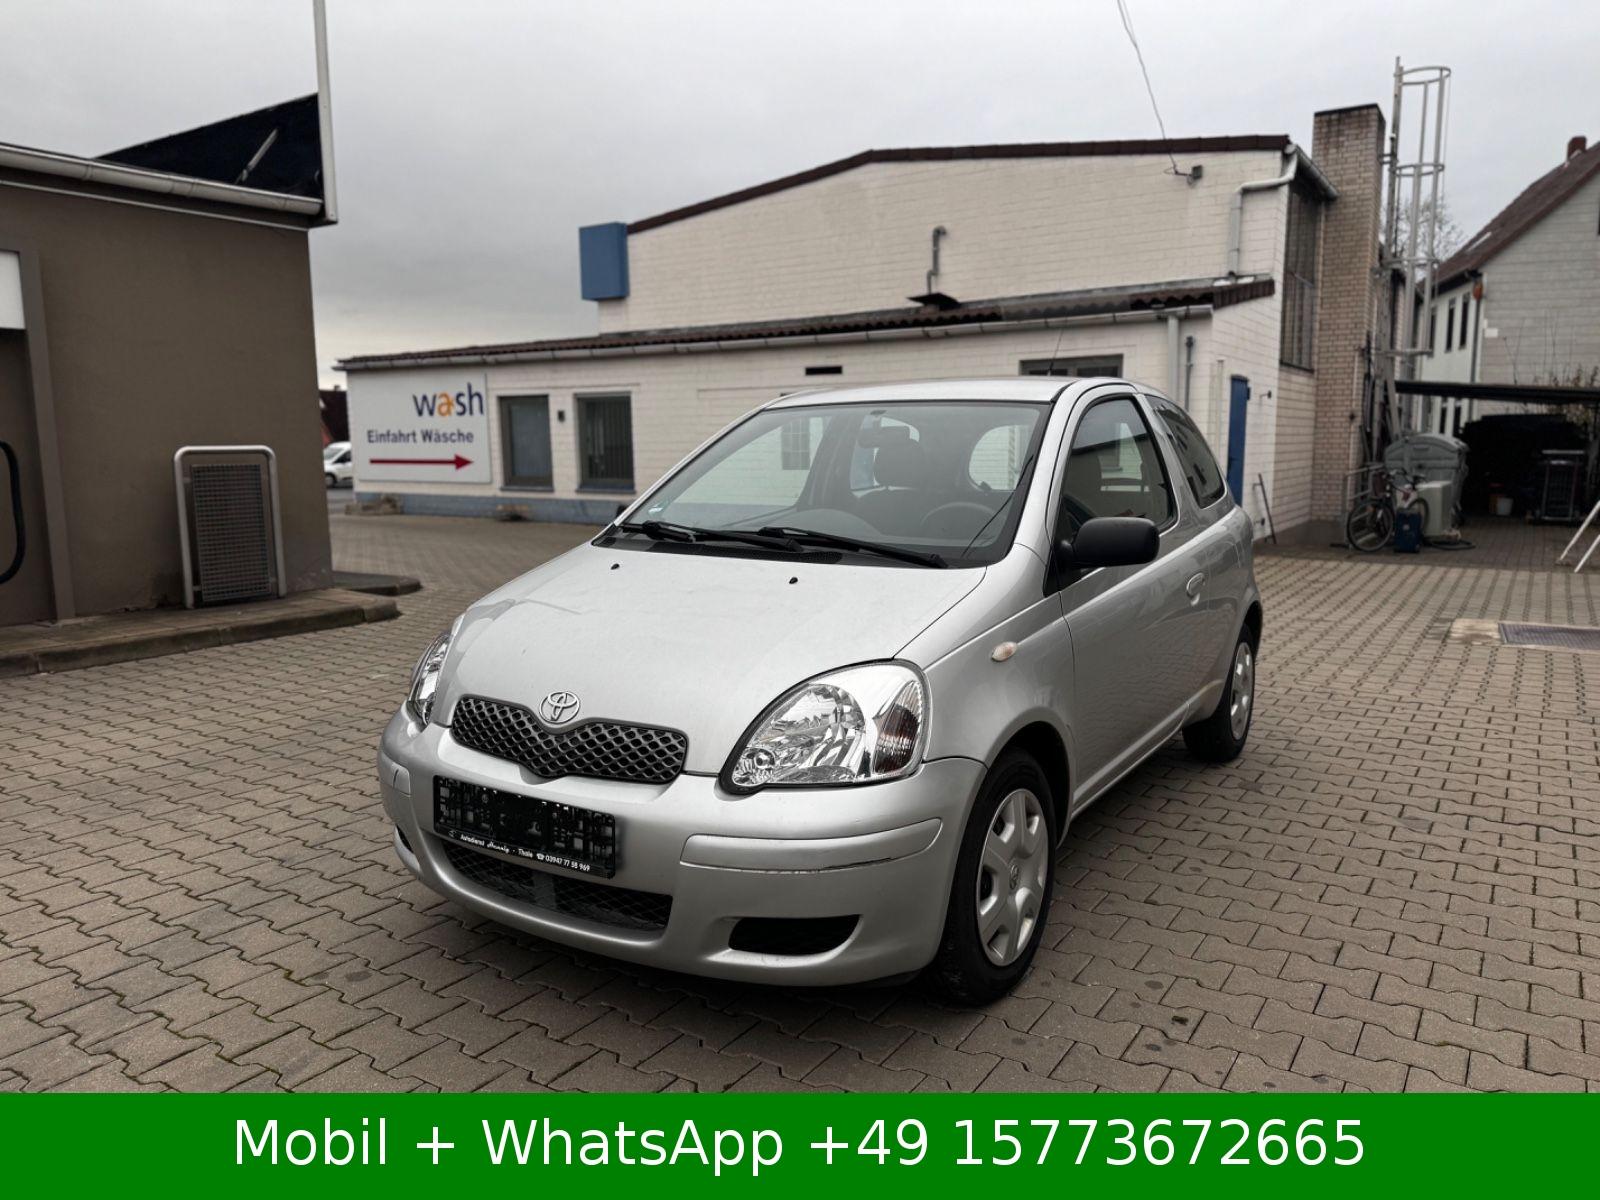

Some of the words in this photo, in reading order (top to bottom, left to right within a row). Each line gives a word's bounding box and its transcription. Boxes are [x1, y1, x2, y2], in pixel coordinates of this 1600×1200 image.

[412, 382, 484, 417] wash
[366, 429, 417, 443] Einfahrt
[420, 428, 474, 443] Wäsche
[518, 848, 533, 858] Thale
[545, 855, 563, 864] 03947
[563, 859, 570, 867] 77
[579, 863, 591, 872] 969
